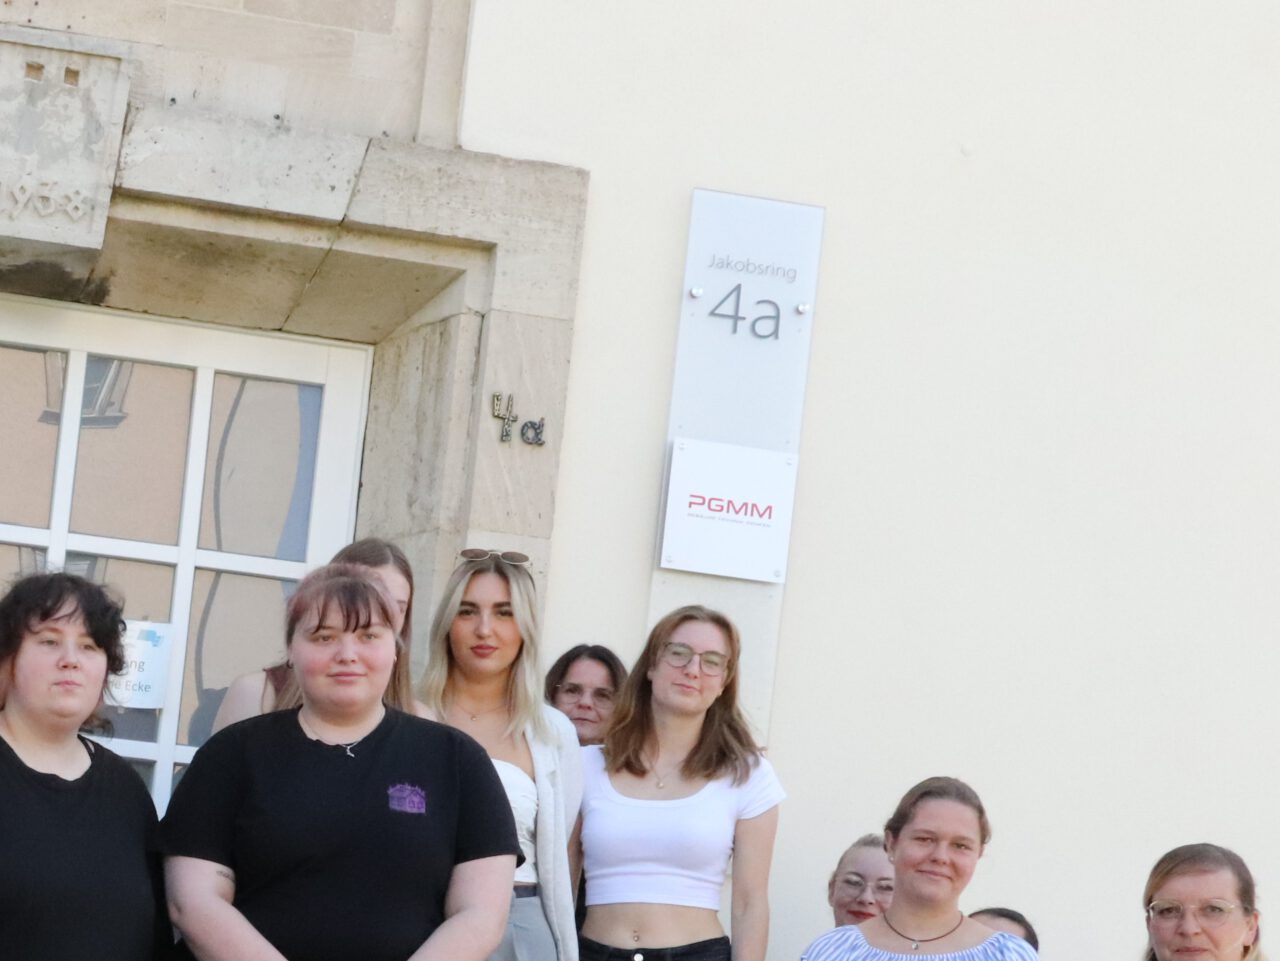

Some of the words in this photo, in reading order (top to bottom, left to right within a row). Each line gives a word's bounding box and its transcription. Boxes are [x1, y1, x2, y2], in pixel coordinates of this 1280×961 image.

[708, 253, 798, 284] Jakobsring
[707, 283, 780, 341] 4a
[491, 391, 546, 447] 4a
[687, 493, 773, 521] PGMM
[125, 680, 152, 693] Ecke
